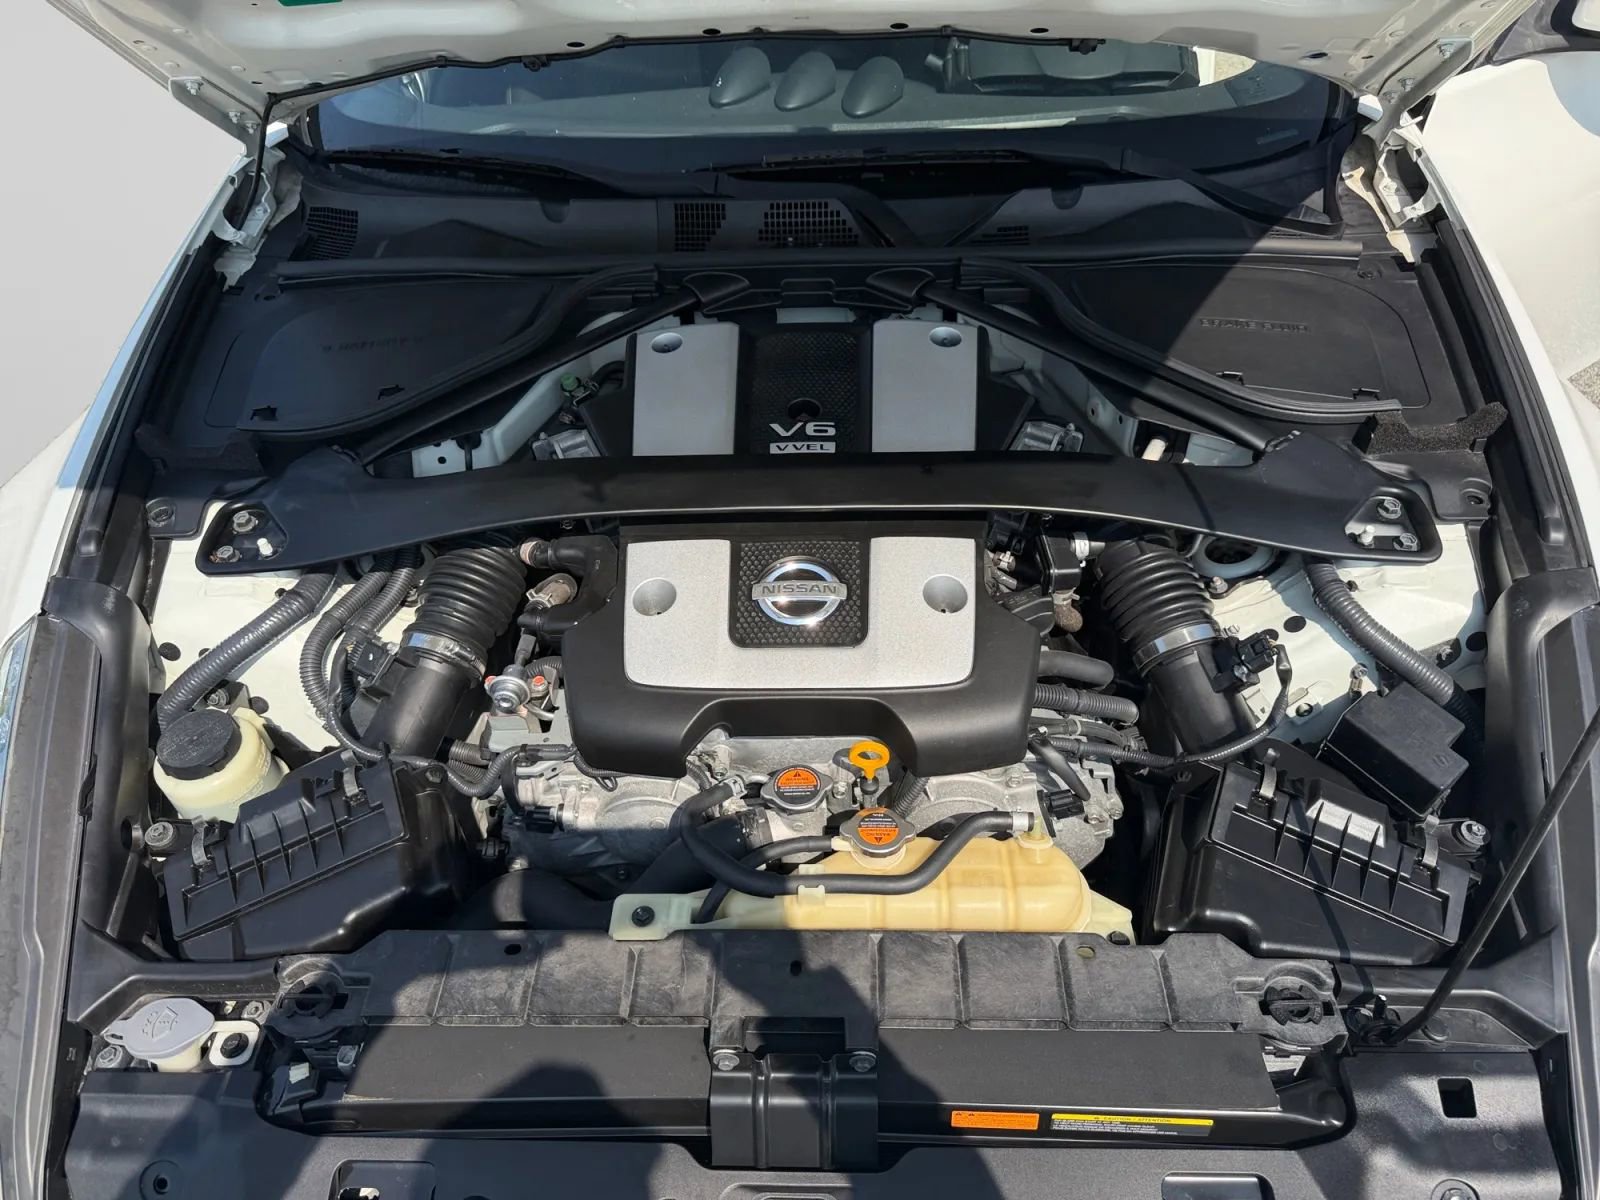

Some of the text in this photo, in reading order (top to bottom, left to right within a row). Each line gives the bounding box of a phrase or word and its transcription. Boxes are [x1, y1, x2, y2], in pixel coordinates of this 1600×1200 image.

[769, 421, 836, 437] V6
[776, 443, 830, 452] VVEL
[762, 583, 837, 595] NISSAN
